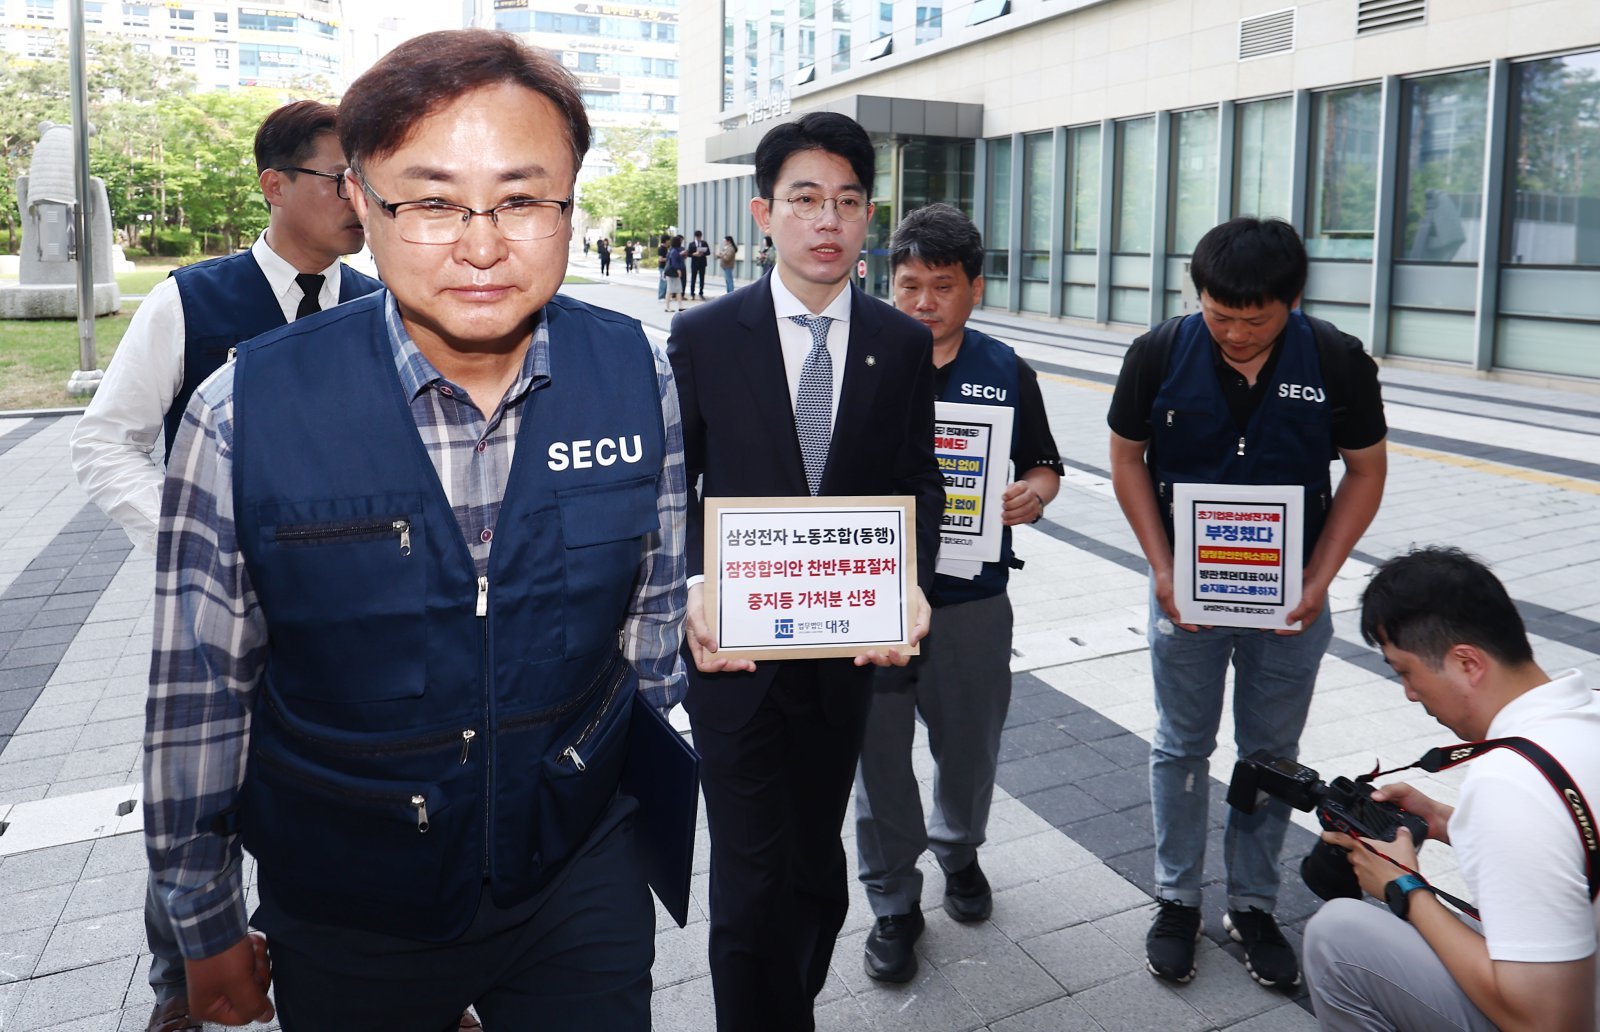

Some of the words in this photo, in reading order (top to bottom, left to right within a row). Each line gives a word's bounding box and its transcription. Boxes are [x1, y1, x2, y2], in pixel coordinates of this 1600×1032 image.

[960, 383, 1007, 402] SECU
[1278, 383, 1326, 403] SECU
[547, 434, 643, 472] SECU
[957, 460, 980, 472] 없이
[955, 499, 975, 510] 없이
[726, 528, 788, 546] 삼성전자
[792, 527, 896, 546] 노동조합(동행)
[1205, 525, 1274, 543] 부정했다
[725, 560, 803, 579] 잠정합의안
[807, 558, 896, 577] 찬반투표절차
[747, 591, 794, 610] 중지등
[798, 590, 843, 609] 가처분
[847, 589, 876, 608] 신청
[825, 619, 850, 634] 대정
[1564, 788, 1597, 851] Canon
